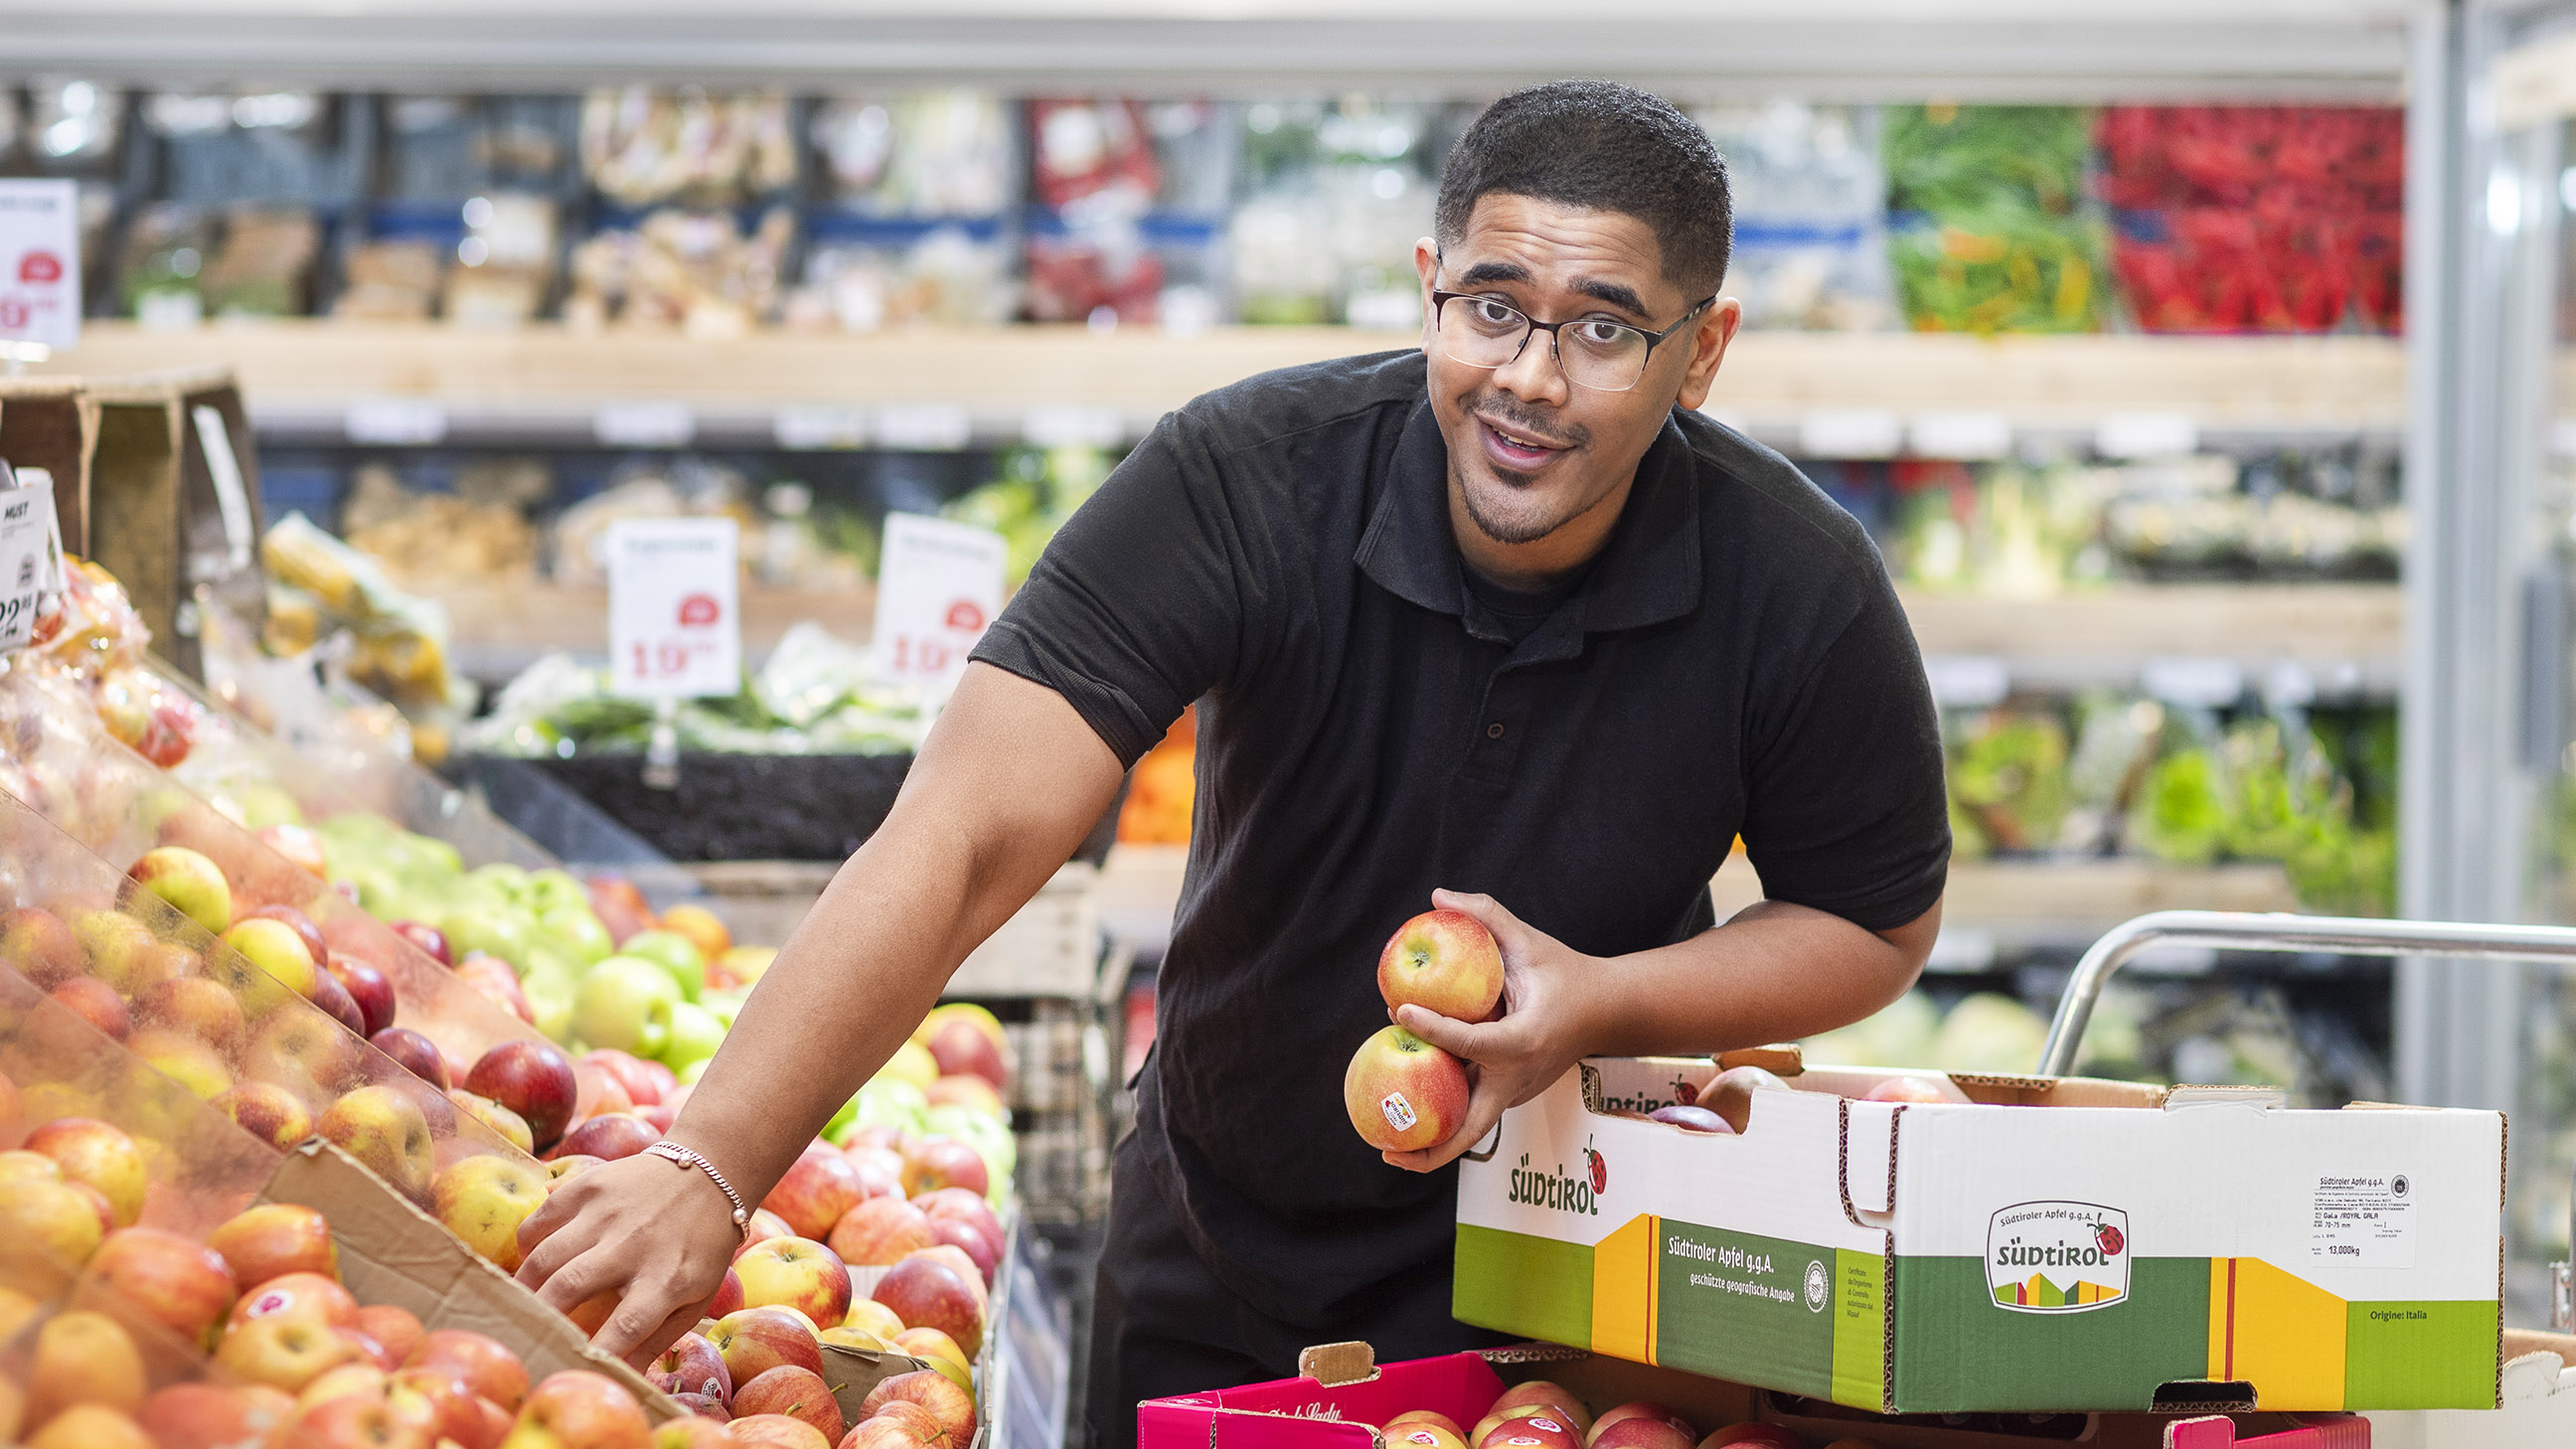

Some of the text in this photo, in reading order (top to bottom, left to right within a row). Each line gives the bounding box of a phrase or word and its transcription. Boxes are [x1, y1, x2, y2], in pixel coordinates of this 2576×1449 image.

[4, 501, 29, 522] MUST
[2320, 1176, 2384, 1188] Südtiroler Apfel g.g.A.
[2001, 1209, 2093, 1227] Südtiroler Apfel g.g.A.
[1668, 1235, 1775, 1275] Südtiroler Apfel g.g.A.
[2329, 1245, 2360, 1256] 13,000kg
[1690, 1273, 1795, 1303] geschützte geografische Angabe
[2369, 1310, 2428, 1322] Origine: Italia
